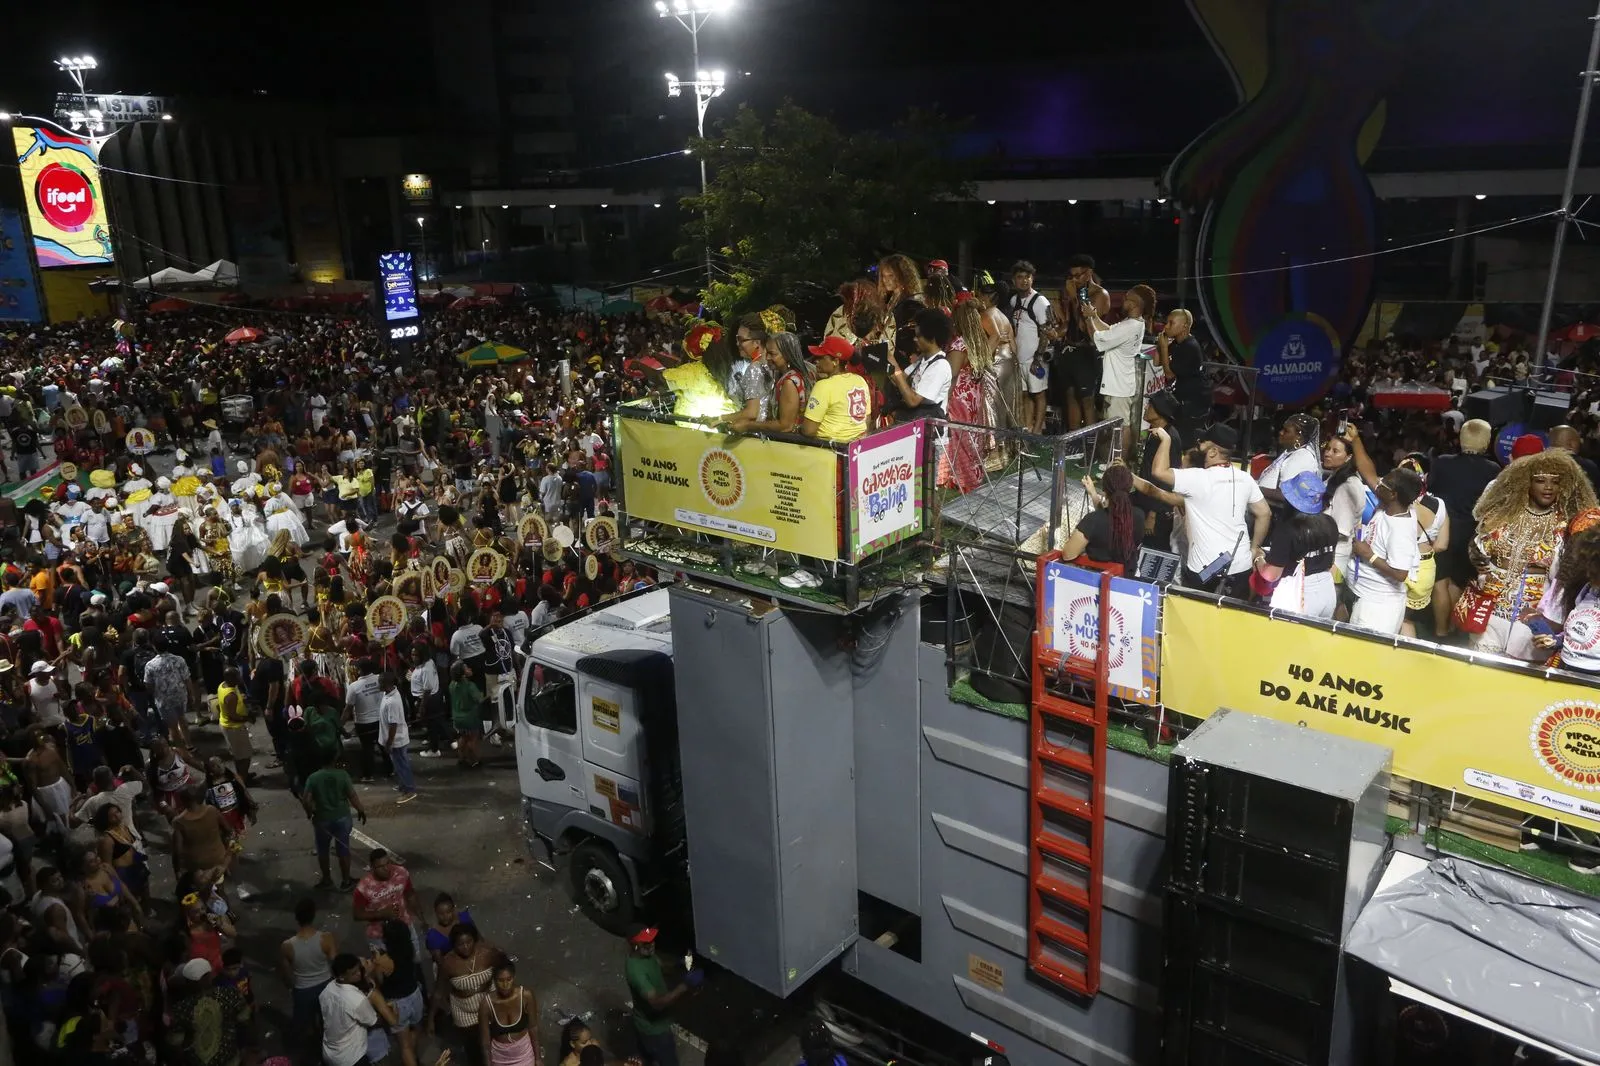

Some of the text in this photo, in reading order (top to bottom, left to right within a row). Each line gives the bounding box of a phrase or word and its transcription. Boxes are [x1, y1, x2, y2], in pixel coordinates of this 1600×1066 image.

[1263, 361, 1322, 376] SALVADOR
[640, 456, 678, 472] 40 ANOS
[632, 467, 690, 488] DO AXÉ MUSIC
[1075, 623, 1116, 647] MUSC
[1080, 640, 1090, 648] 40
[1288, 663, 1384, 701] 40 ANOS
[1260, 679, 1412, 734] DO AXÉ MUSIC
[1576, 741, 1593, 750] DAS
